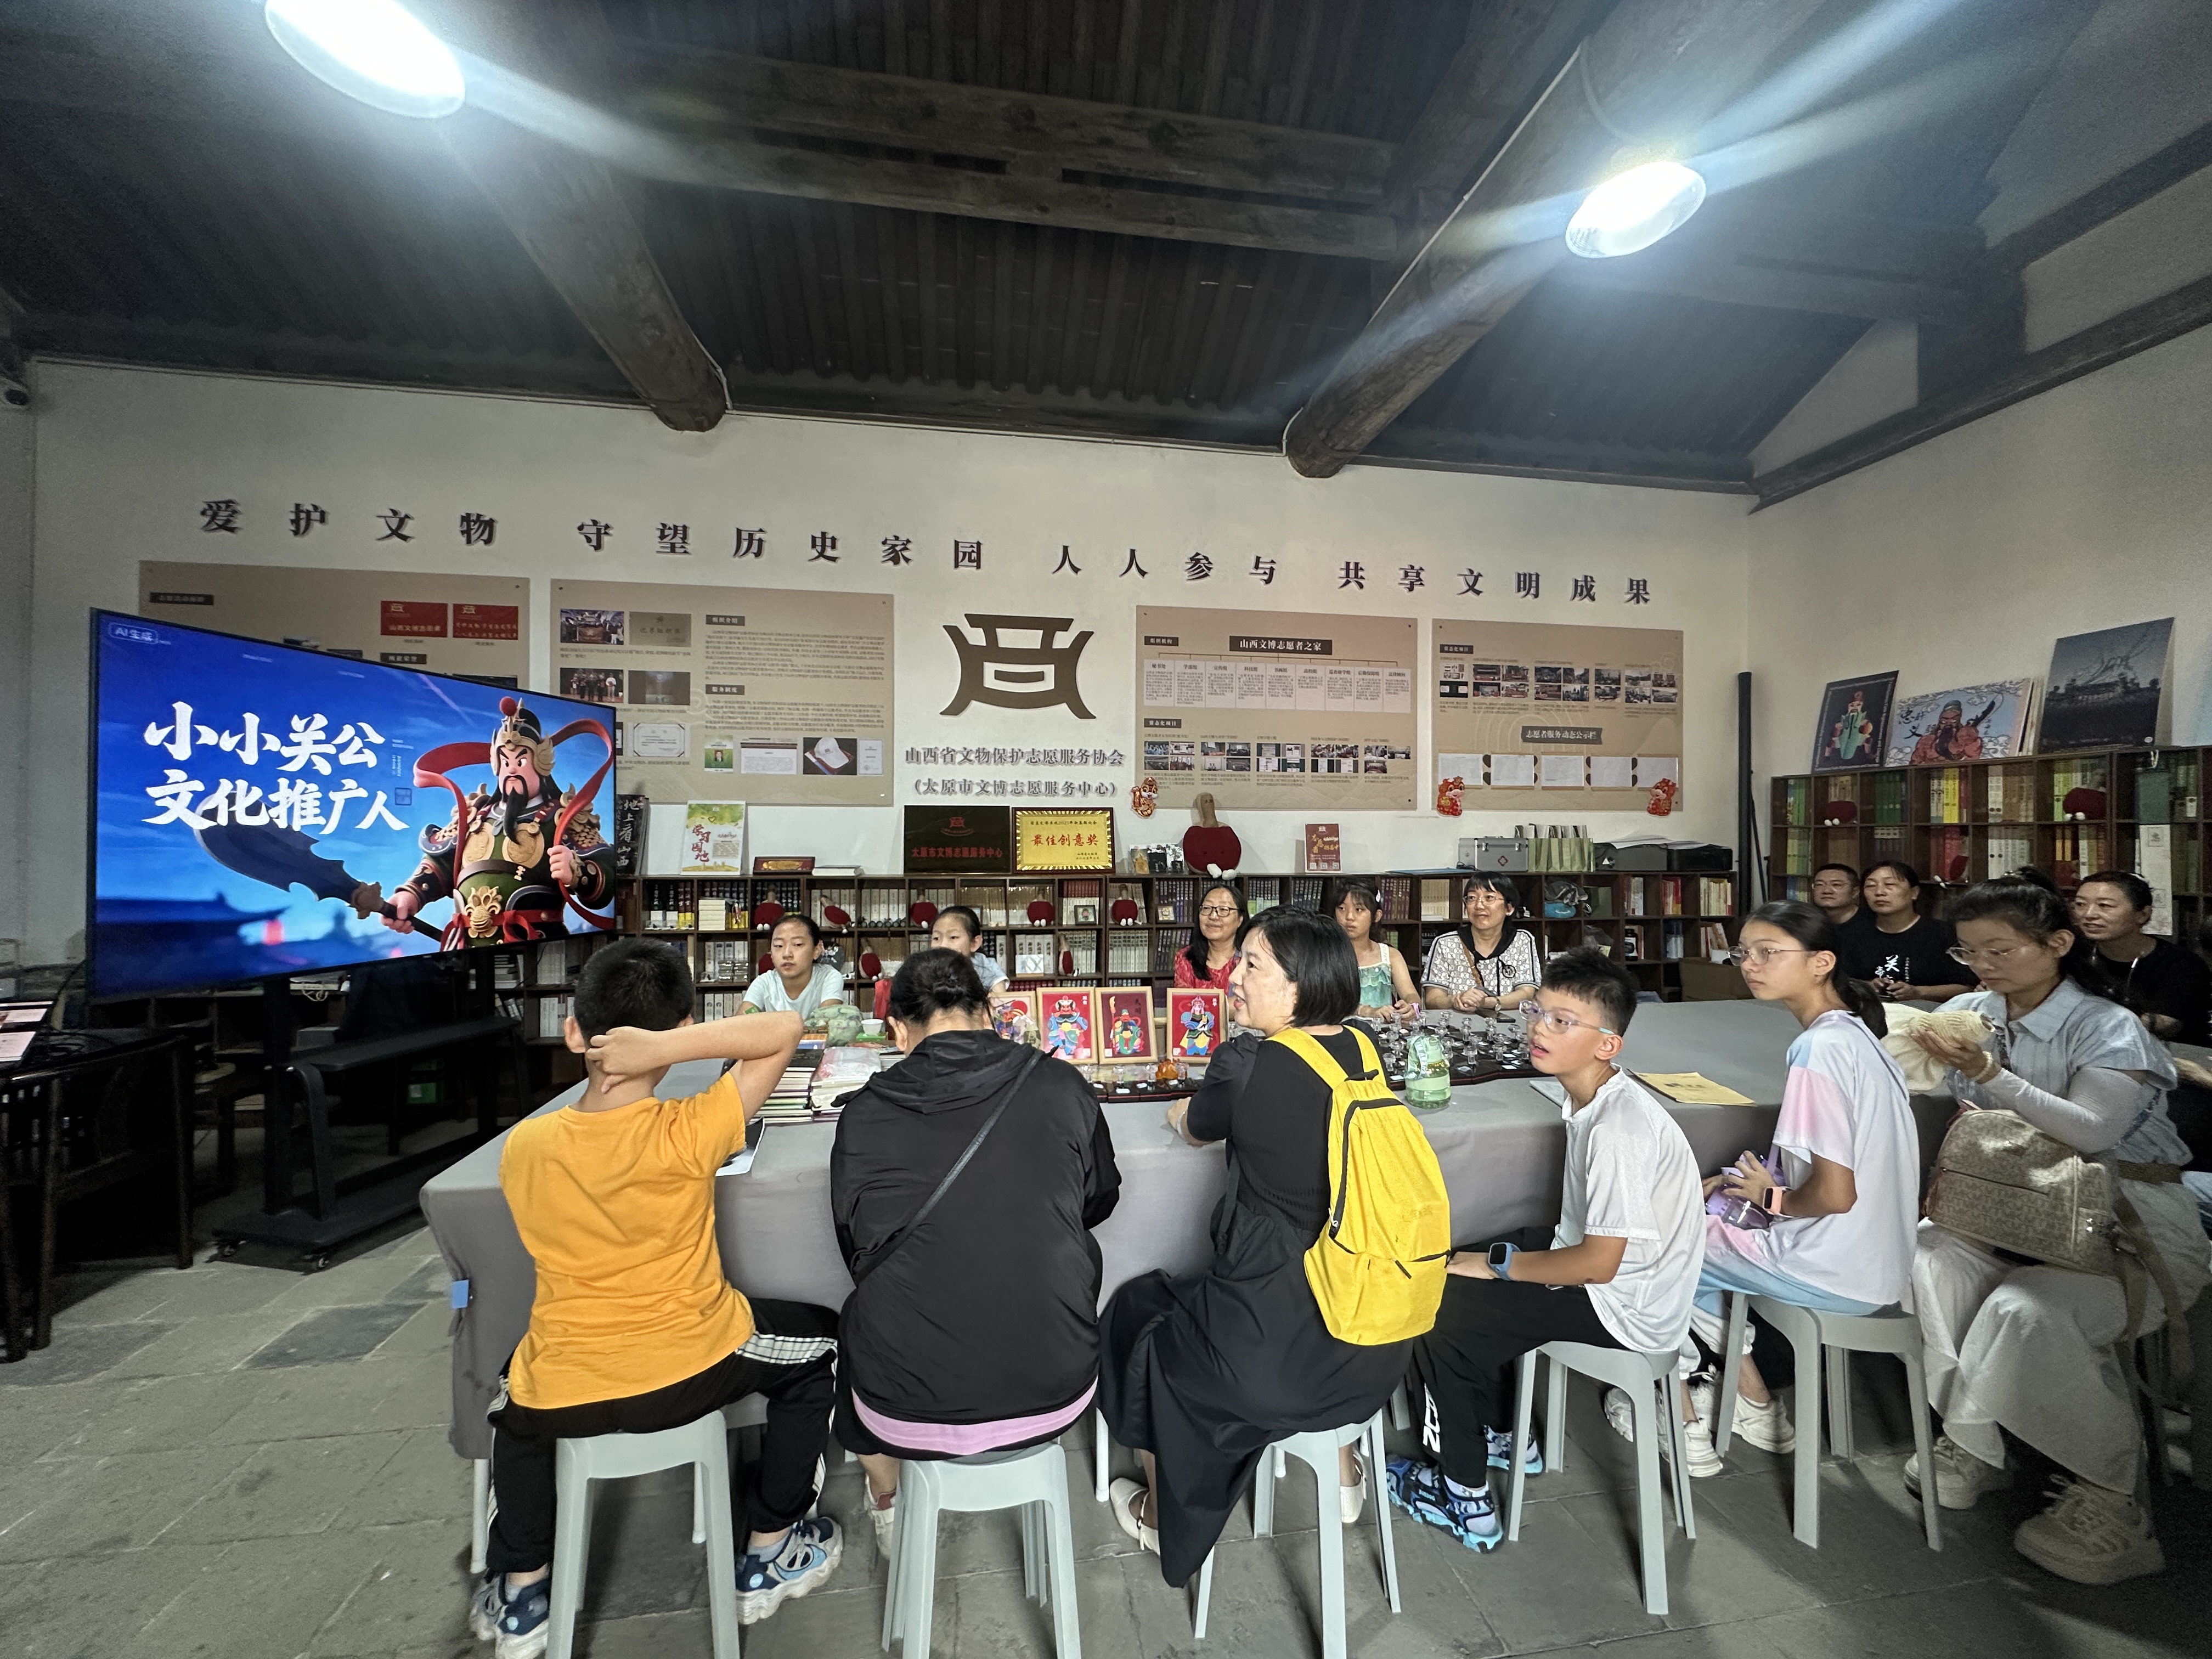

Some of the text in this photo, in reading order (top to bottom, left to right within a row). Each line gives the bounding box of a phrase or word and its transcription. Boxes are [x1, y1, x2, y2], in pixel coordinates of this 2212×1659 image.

[200, 499, 1651, 604] 爱护文物 守望历史家园 人人参与 共享文明成果
[1239, 639, 1322, 651] 山西文博志愿者之家
[144, 701, 385, 776] 小小关公
[1526, 730, 1596, 739] 志愿者服务动态公示栏
[905, 747, 1125, 766] 山西省文物保护志愿服务协会
[141, 769, 409, 835] 文化推广人
[617, 799, 640, 867] 地上看山西
[1031, 833, 1098, 847] 最佳创意奖
[911, 847, 1003, 859] 太原市文博志愿服务中心
